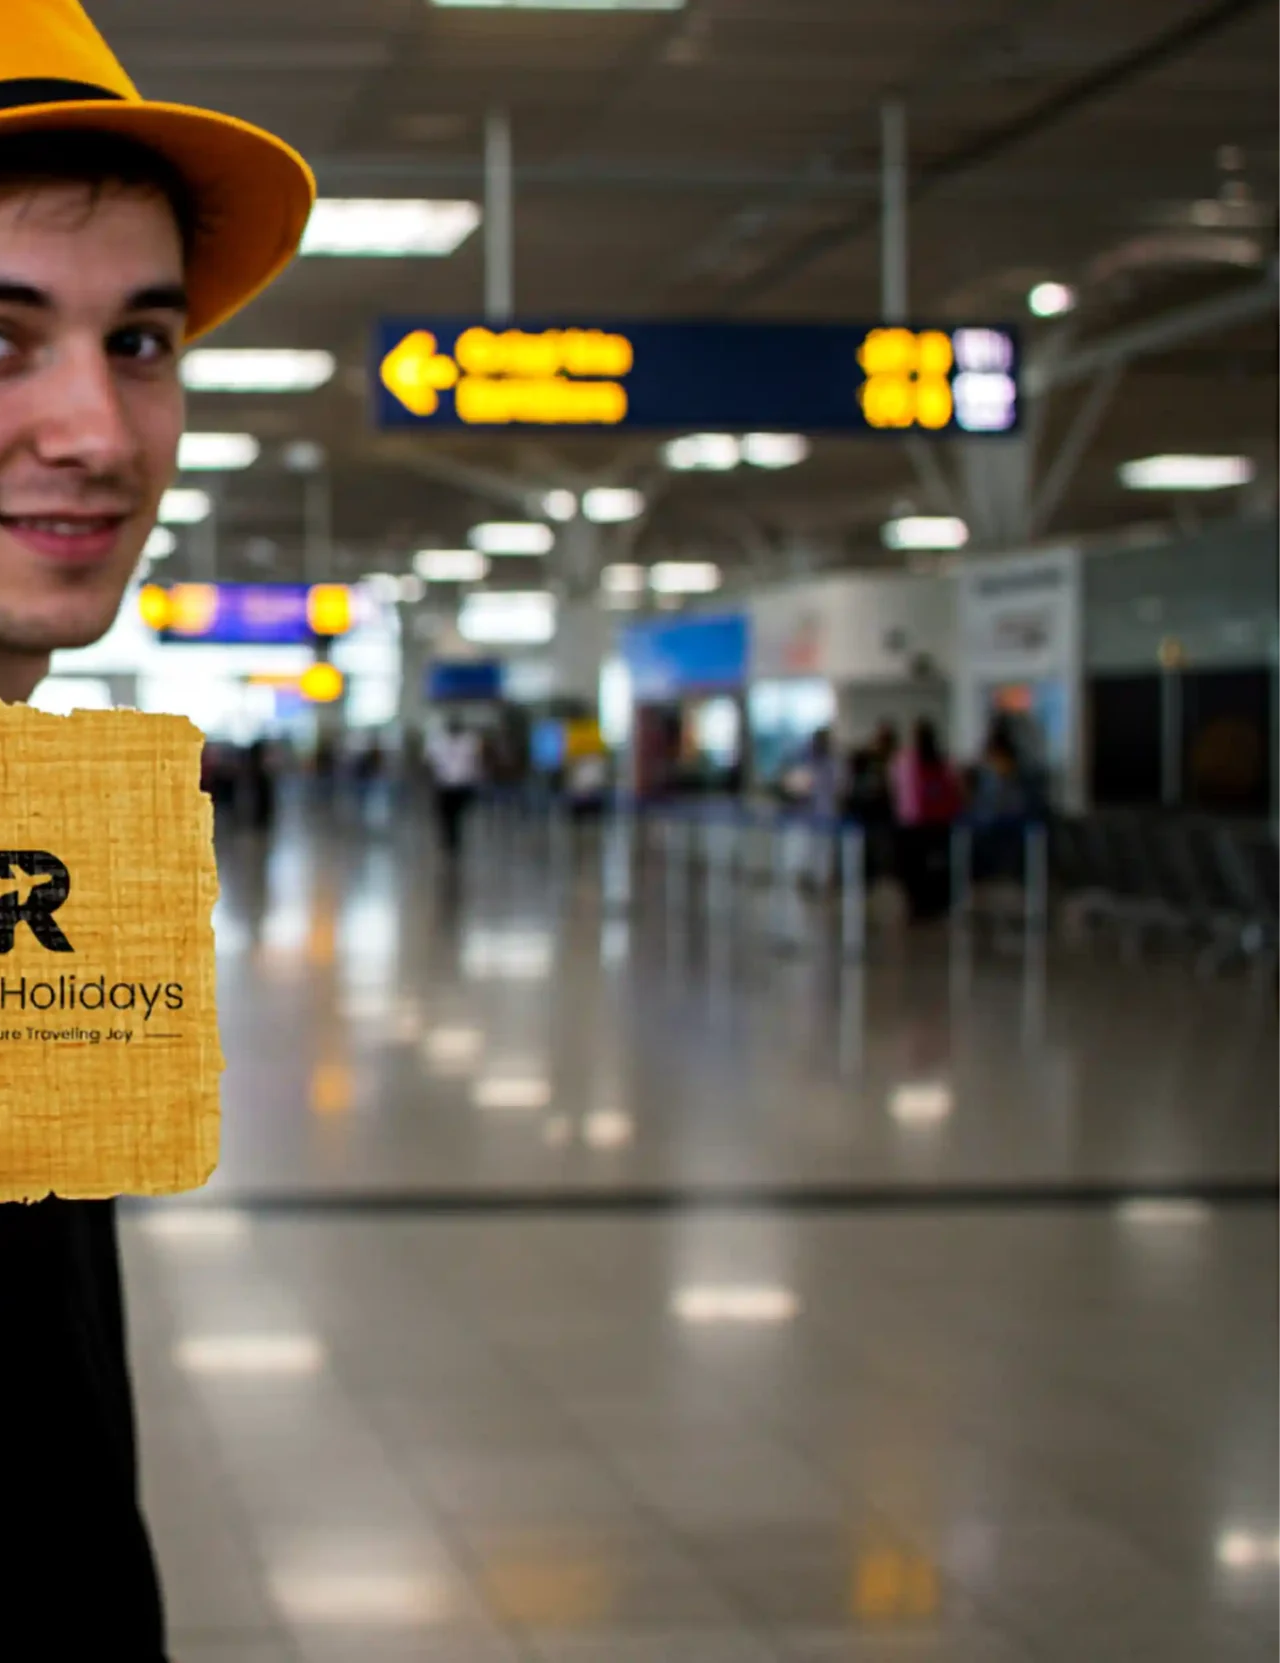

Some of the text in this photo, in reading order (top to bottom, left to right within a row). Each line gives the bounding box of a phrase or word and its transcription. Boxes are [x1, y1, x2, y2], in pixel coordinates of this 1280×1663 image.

[0, 975, 184, 1020] Holidays
[26, 1027, 100, 1044] Traveling
[106, 1027, 133, 1043] Joy
